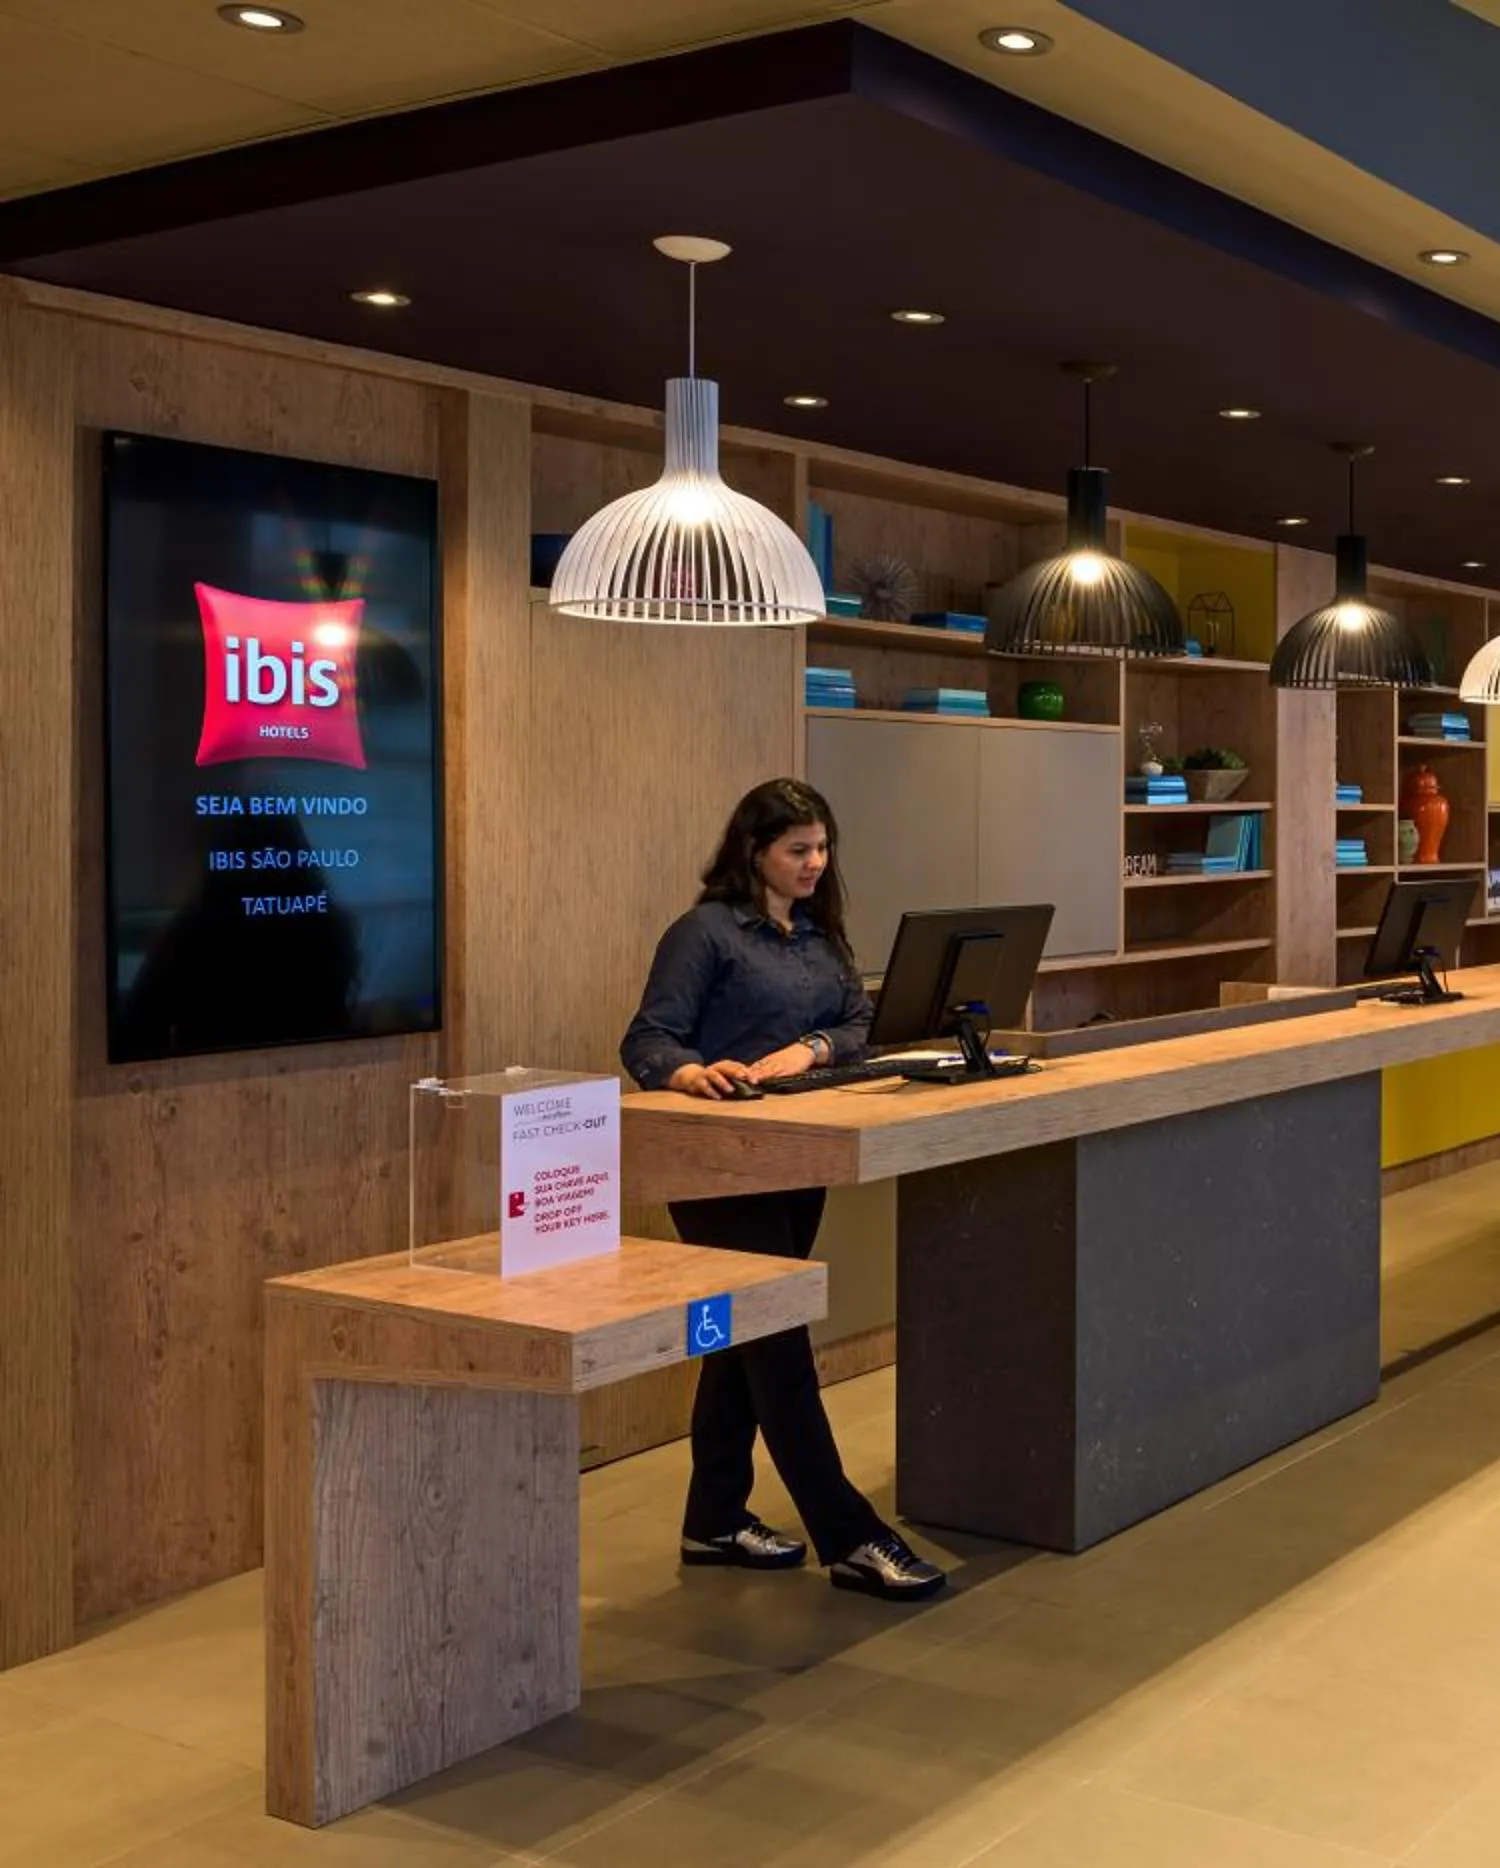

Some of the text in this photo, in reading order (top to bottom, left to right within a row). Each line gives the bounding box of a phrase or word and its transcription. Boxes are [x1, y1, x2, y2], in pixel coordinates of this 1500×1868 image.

[225, 635, 339, 707] ibis
[259, 725, 309, 740] HOTELS
[196, 796, 368, 815] SEJA BEM VINDO
[209, 847, 359, 870] IBIS SÃO PAULO
[241, 891, 328, 915] TATUAPÉ
[513, 1097, 573, 1117] WELCOME
[512, 1127, 540, 1141] FAST
[534, 1165, 581, 1181] COLOQUE
[563, 1216, 582, 1228] KEY
